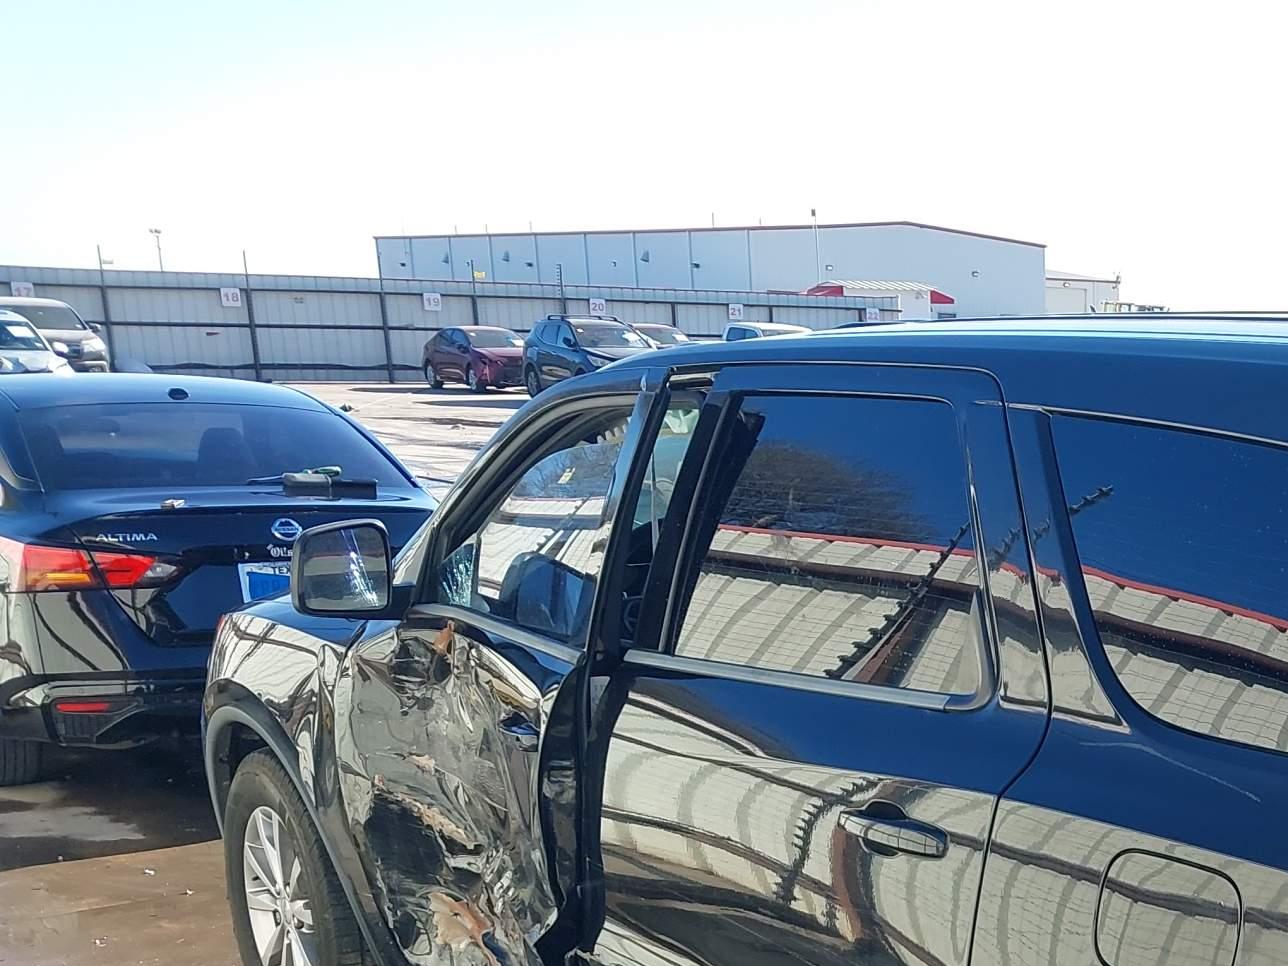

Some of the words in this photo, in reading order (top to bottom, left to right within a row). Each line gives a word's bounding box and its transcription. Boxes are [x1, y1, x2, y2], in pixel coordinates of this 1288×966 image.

[223, 292, 239, 302] 18
[425, 296, 440, 307] 19
[591, 302, 605, 312] 20
[730, 307, 742, 316] 21
[95, 532, 159, 542] ALTIMA
